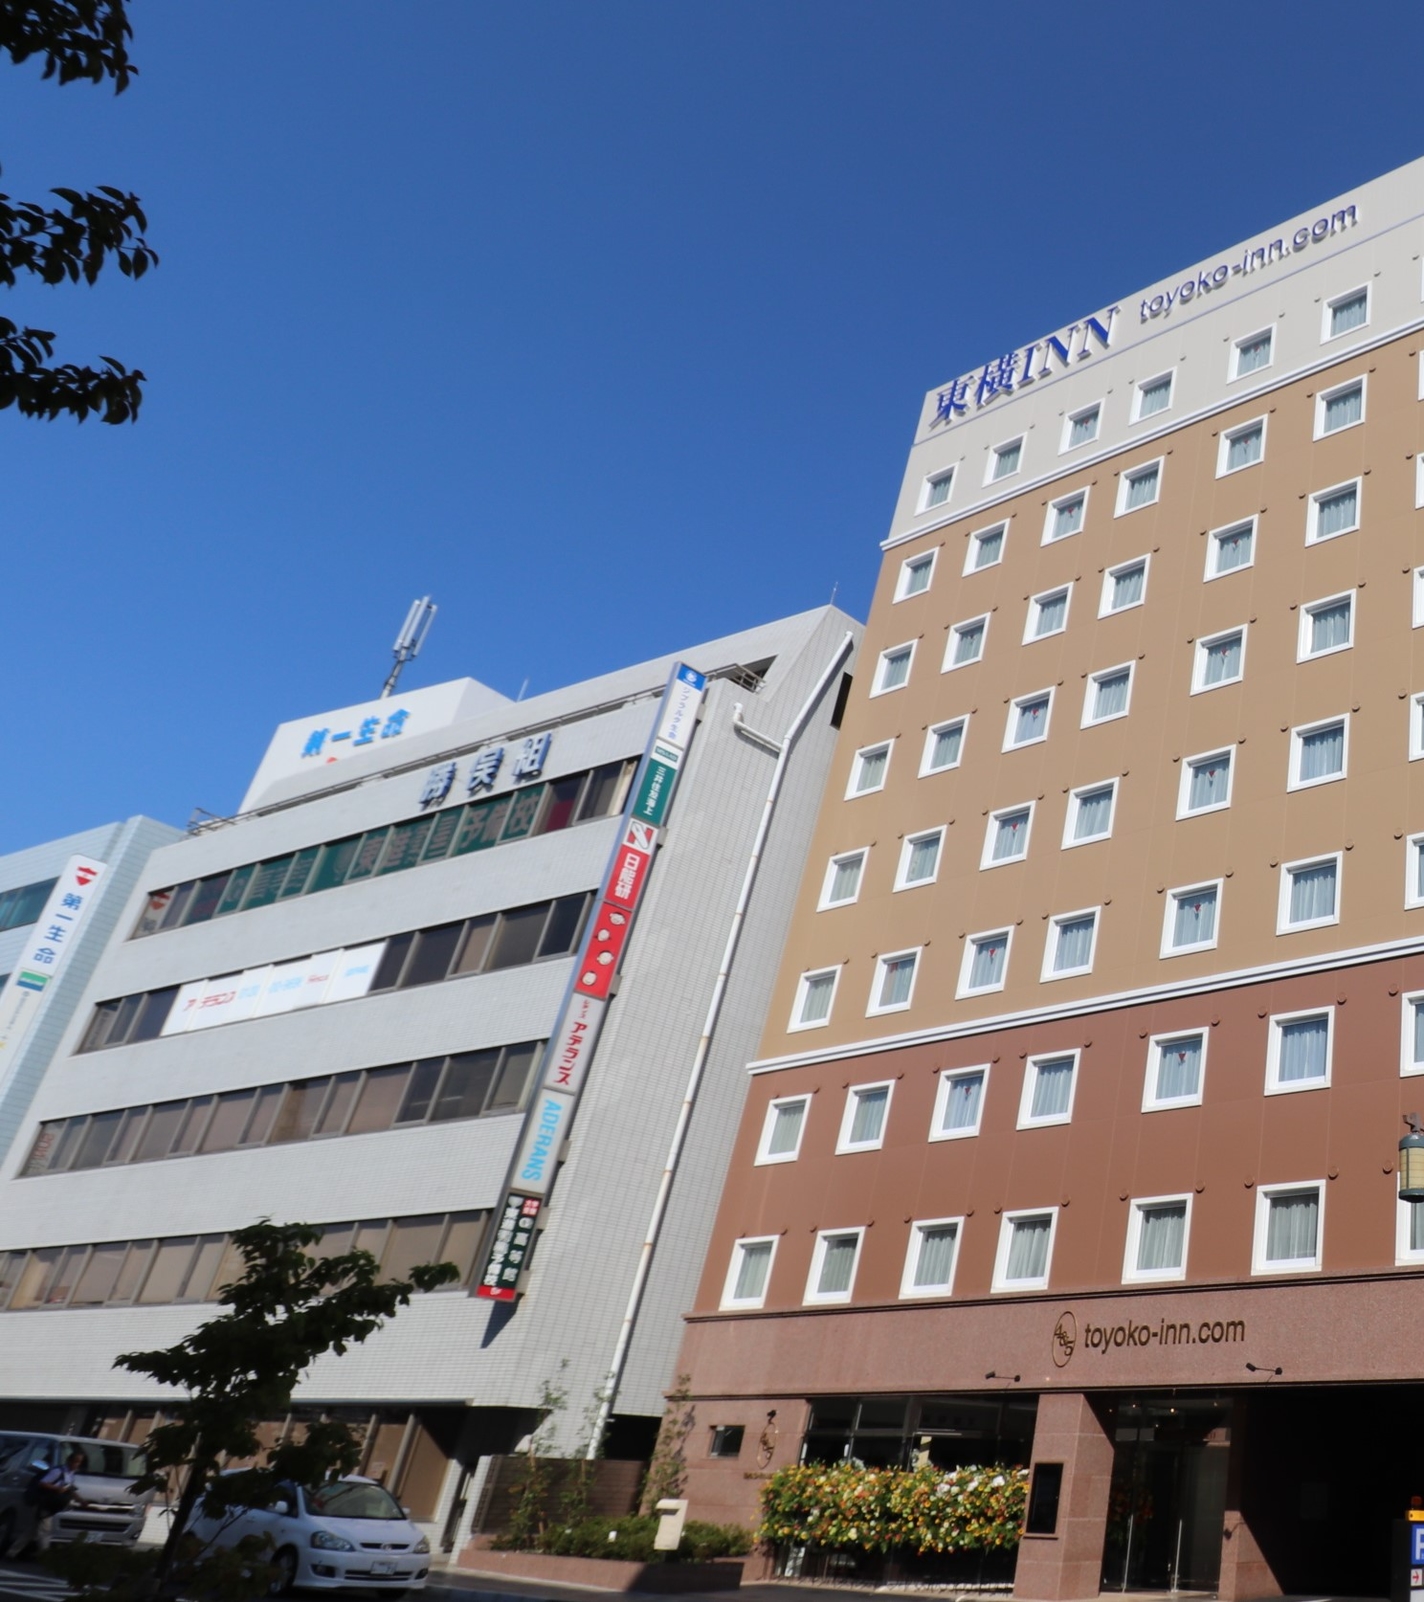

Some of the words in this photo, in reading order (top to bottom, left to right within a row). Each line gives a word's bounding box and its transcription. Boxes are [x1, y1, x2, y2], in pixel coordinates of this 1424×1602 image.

[1140, 204, 1357, 319] toyoko-inn.com
[930, 306, 1118, 428] 東横INN
[301, 709, 410, 758] 第一生命
[614, 852, 641, 899] 日能研
[33, 893, 84, 964] 第一生命
[554, 1021, 588, 1086] アデランス
[521, 1098, 563, 1182] ADERANS
[1084, 1317, 1246, 1355] toyoko-inn.com
